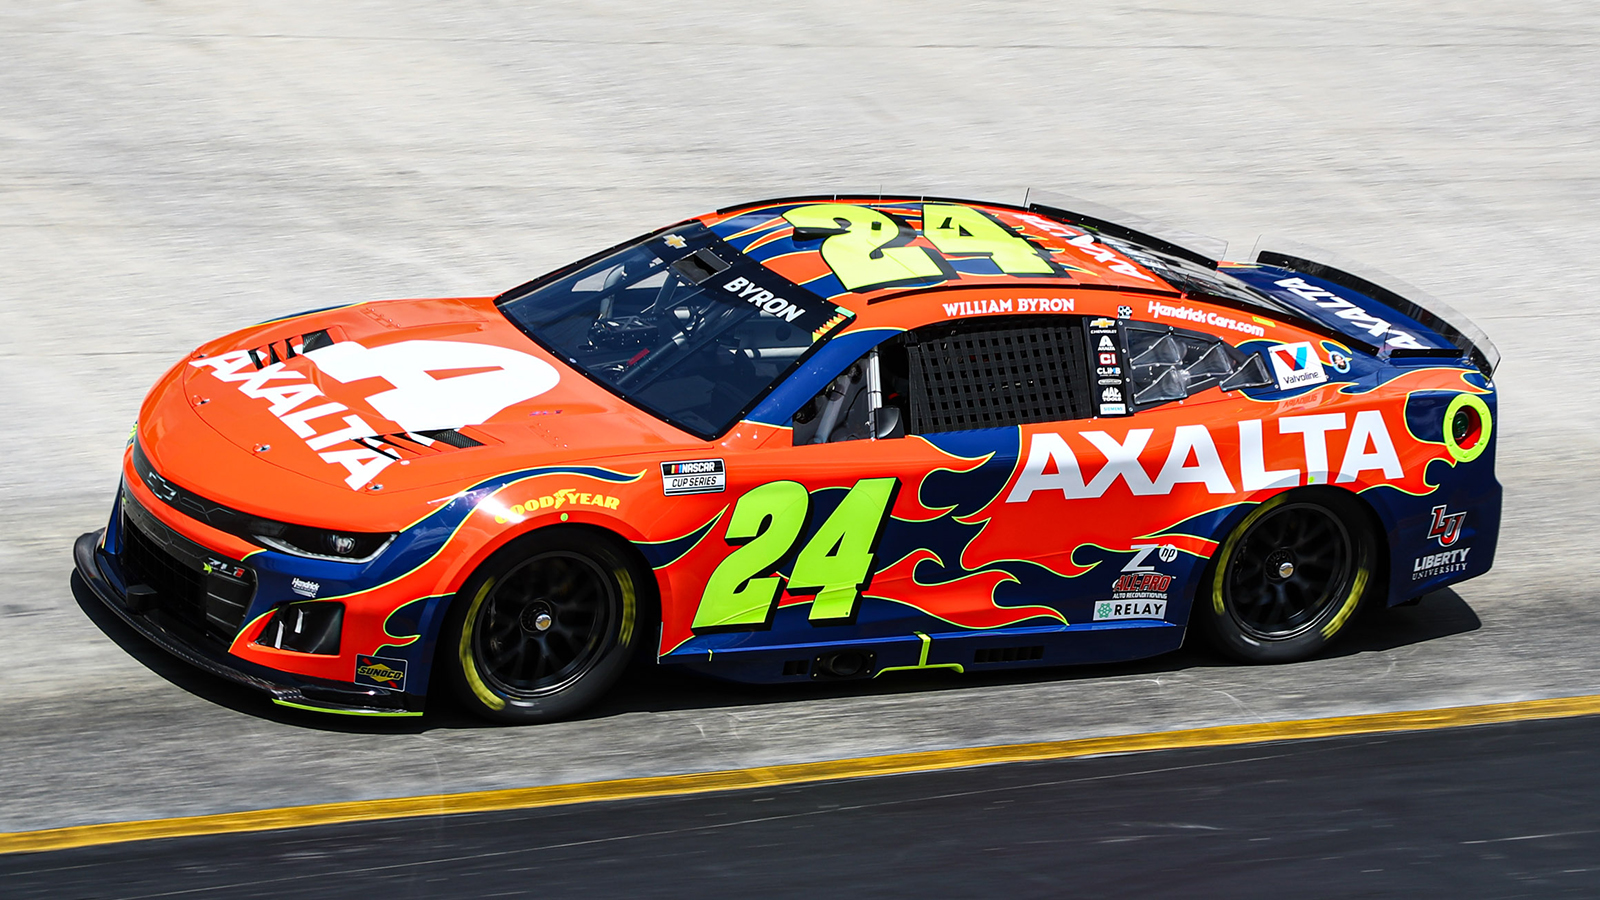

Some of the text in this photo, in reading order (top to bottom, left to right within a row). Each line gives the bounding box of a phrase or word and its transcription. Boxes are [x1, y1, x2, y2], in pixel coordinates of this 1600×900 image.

[781, 203, 1056, 291] 24
[722, 276, 806, 323] BYRON
[942, 298, 1075, 317] WILLIAM BYRON
[1273, 277, 1431, 350] AXALTA
[1283, 371, 1319, 384] Valvoline
[187, 349, 402, 491] AXALTA
[1006, 409, 1405, 503] AXALTA
[682, 461, 716, 473] NASCAR
[671, 476, 717, 487] CUP SERIES
[1427, 504, 1468, 548] LU
[691, 477, 898, 630] 24
[1159, 544, 1178, 562] hp
[1413, 547, 1471, 572] LIBERTY
[1412, 562, 1467, 580] UNIVERSITY
[1113, 575, 1172, 592] ALL-PRO
[1114, 603, 1163, 616] RELAY
[359, 666, 402, 680] SUNOCO
